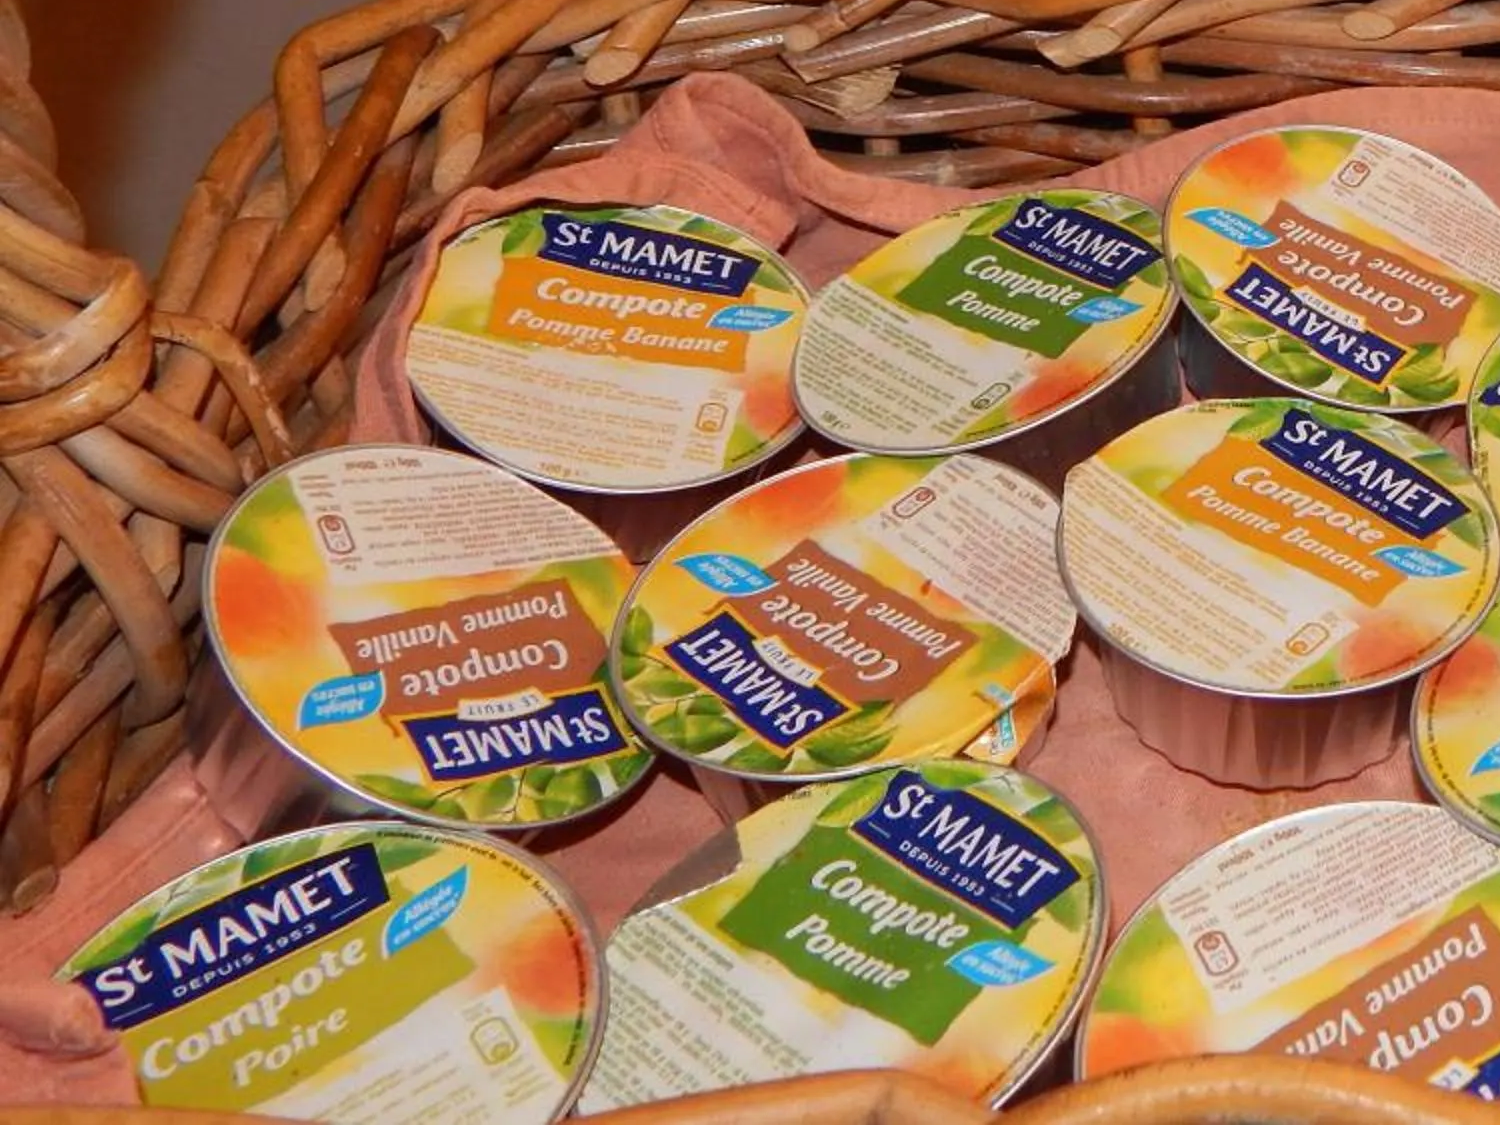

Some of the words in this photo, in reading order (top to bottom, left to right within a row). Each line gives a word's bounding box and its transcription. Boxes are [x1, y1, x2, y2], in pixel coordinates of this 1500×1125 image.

[553, 221, 593, 248] St
[599, 232, 742, 279] MAMET
[589, 258, 648, 276] DEPUIS
[1016, 205, 1045, 229] St
[1044, 217, 1147, 271] MAMET
[1279, 218, 1361, 266] Vanille
[536, 277, 707, 320] Compote
[962, 254, 1083, 306] Compote
[1276, 250, 1426, 327] Compote
[1366, 257, 1466, 310] Pomme
[508, 308, 613, 343] Pomme
[621, 326, 729, 354] Banane
[946, 290, 1041, 332] Pomme
[1234, 277, 1358, 357] MAMET
[1352, 343, 1391, 373] St
[1279, 419, 1324, 445] St
[1317, 439, 1452, 520] MAMET
[1303, 460, 1352, 496] DEPUIS
[1188, 484, 1282, 536] Pomme
[1283, 526, 1381, 584] Banane
[1232, 465, 1386, 546] Compote
[463, 590, 569, 633] Pomme
[786, 557, 865, 613] Vanille
[355, 620, 456, 661] Vanille
[759, 593, 901, 683] Compote
[866, 601, 964, 661] Pomme
[402, 638, 569, 698] Compote
[680, 628, 799, 716] MAMET
[426, 718, 575, 770] MAMET
[572, 707, 611, 741] St
[779, 705, 823, 736] St
[884, 784, 935, 820] St
[924, 804, 1061, 900] MAMET
[899, 840, 949, 878] DEPUIS
[951, 872, 985, 896] 1953
[95, 958, 153, 1008] St
[163, 856, 353, 980] MAMET
[811, 859, 970, 949] Compote
[172, 953, 256, 999] DEPUIS
[265, 922, 318, 955] 1953
[785, 913, 910, 991] Pomme
[1365, 922, 1488, 1014] Pomme
[140, 935, 368, 1081] Compote
[1370, 984, 1494, 1071] Comp
[232, 1003, 350, 1088] Poire
